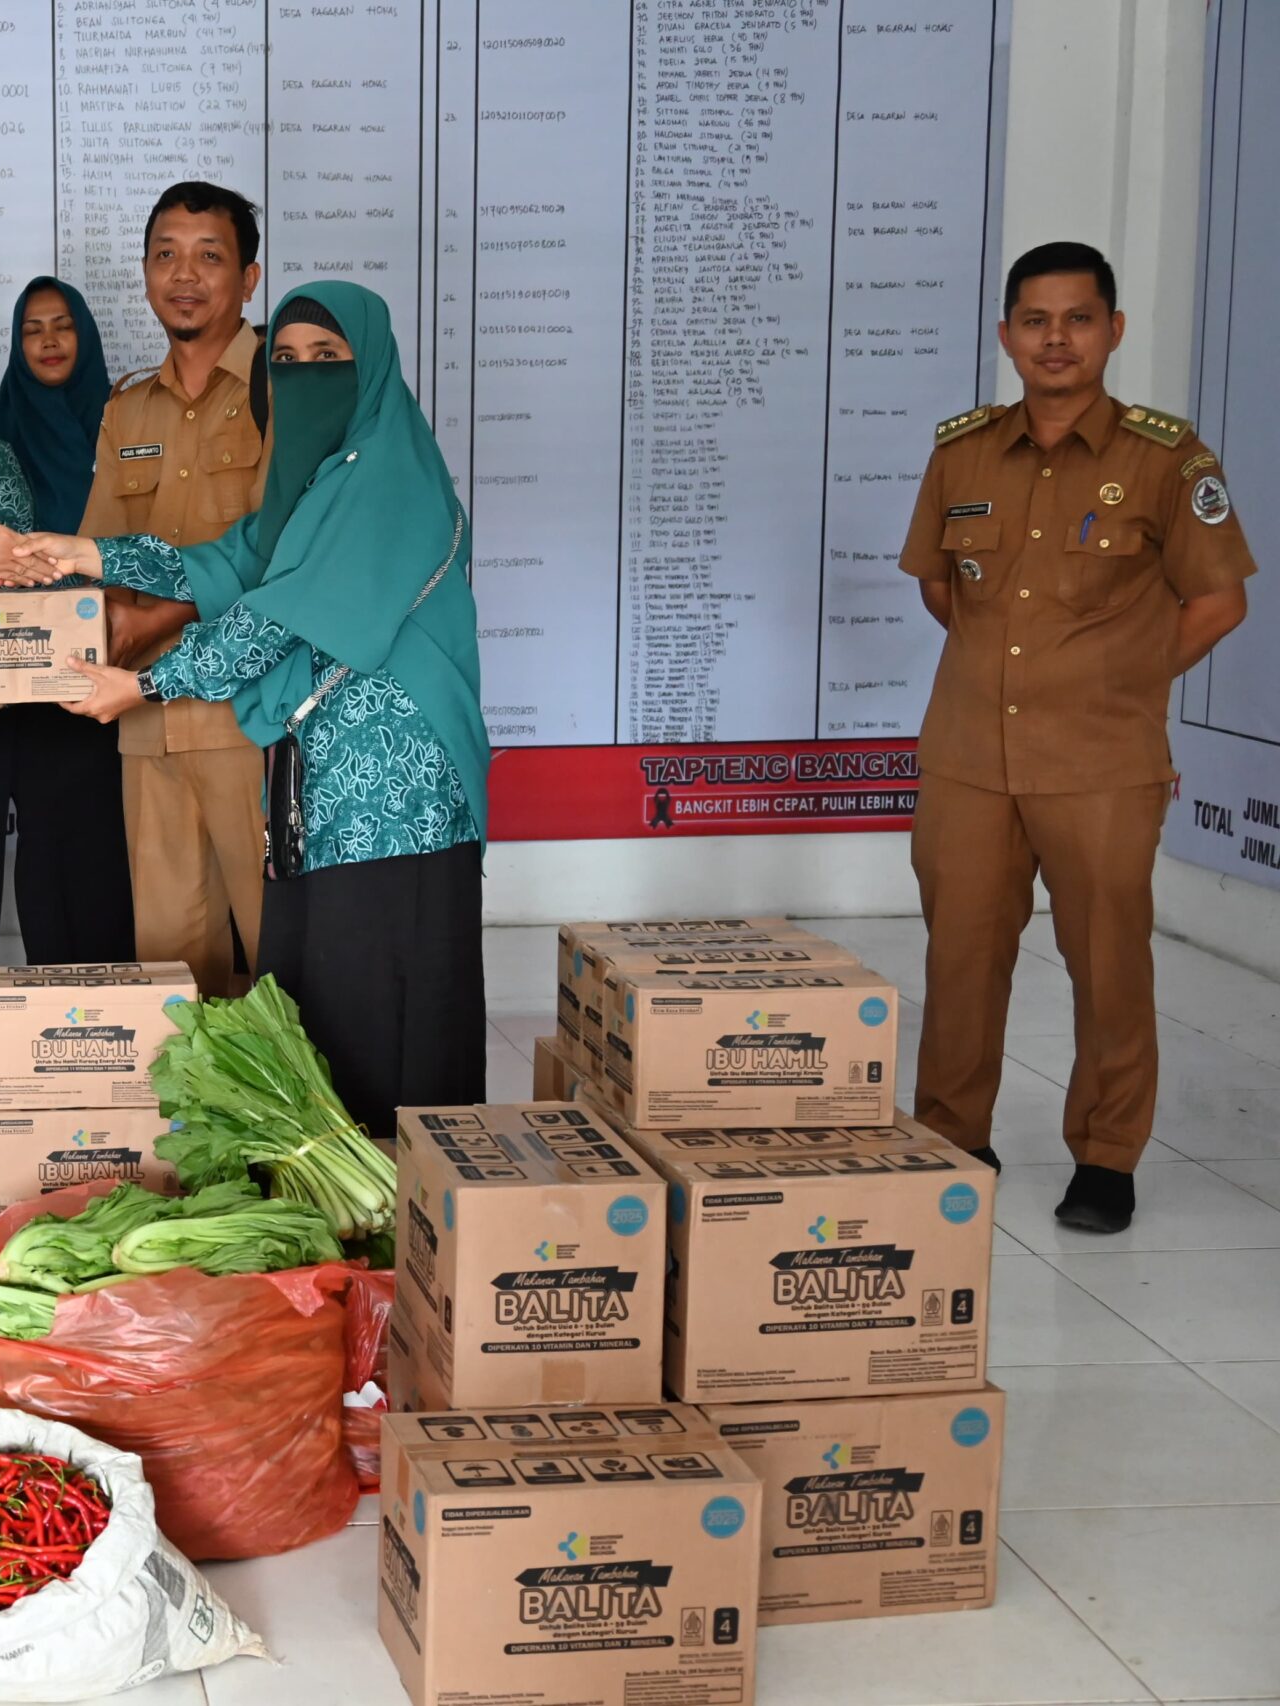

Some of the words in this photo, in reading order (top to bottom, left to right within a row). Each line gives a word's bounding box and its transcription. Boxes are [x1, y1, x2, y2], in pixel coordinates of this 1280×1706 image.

[642, 755, 788, 784] TAPTENG
[675, 799, 732, 814] BANGKIT
[736, 798, 769, 813] LEBIH
[773, 797, 818, 813] CEPAT,
[822, 796, 856, 811] PULIH
[860, 795, 893, 810] LEBIH
[1194, 800, 1233, 837] TOTAL
[53, 1027, 82, 1038] Makanan
[85, 1027, 115, 1037] Tambahan
[32, 1040, 67, 1058] IBU
[72, 1040, 139, 1057] HAMIL
[706, 1048, 746, 1070] IBU
[751, 1048, 828, 1069] HAMIL
[871, 1067, 878, 1077] 4
[39, 1163, 74, 1181] IBU
[79, 1162, 144, 1181] HAMIL
[612, 1211, 644, 1224] 2025
[790, 1252, 833, 1266] Makanan
[838, 1250, 883, 1263] Tambahan
[512, 1272, 555, 1287] Makanan
[560, 1271, 606, 1285] Tambahan
[774, 1267, 905, 1305] BALITA
[495, 1289, 628, 1325] BALITA
[957, 1301, 966, 1313] 4
[820, 1321, 850, 1329] VITAMIN
[786, 1490, 914, 1529] BALITA
[966, 1521, 975, 1534] 4
[538, 1568, 584, 1583] Makanan
[589, 1565, 639, 1580] Tambahan
[519, 1585, 662, 1624] BALITA
[720, 1619, 730, 1633] 4
[511, 1644, 556, 1652] DIPERKAYA
[558, 1643, 568, 1651] 10
[570, 1641, 603, 1650] VITAMIN
[605, 1640, 621, 1648] DAN
[630, 1638, 667, 1646] MINERAL
